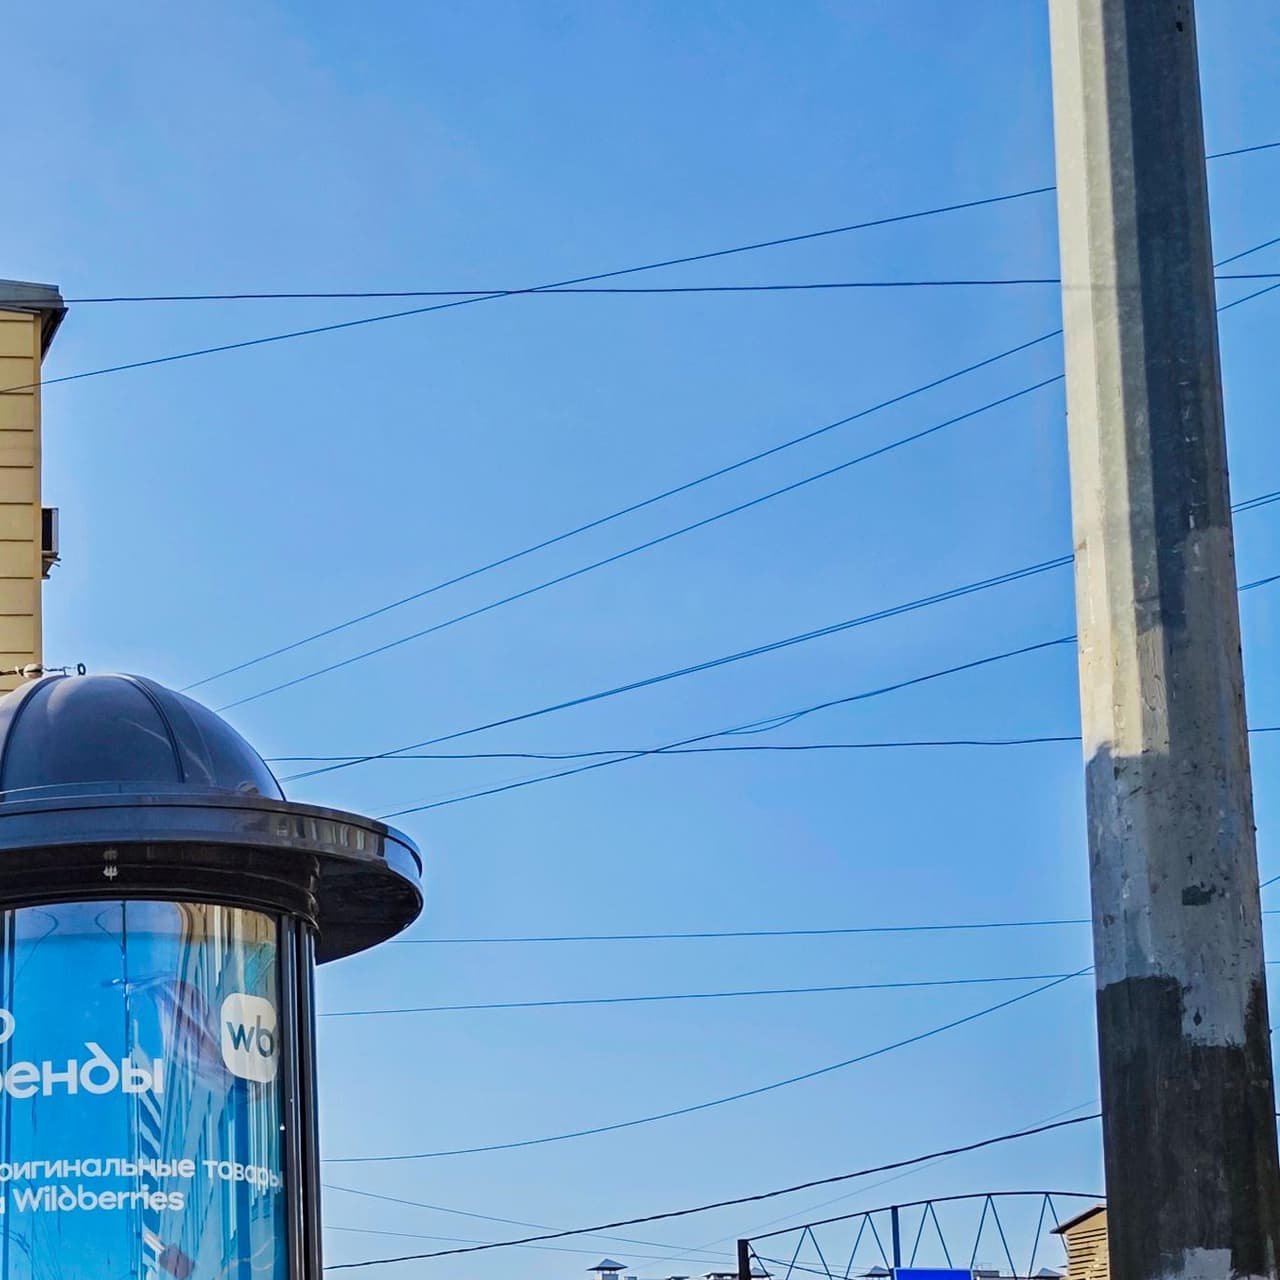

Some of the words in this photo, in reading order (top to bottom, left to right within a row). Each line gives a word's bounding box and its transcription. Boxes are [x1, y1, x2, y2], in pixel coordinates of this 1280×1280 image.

[226, 1015, 275, 1058] wb
[202, 1159, 284, 1192] товары
[12, 1184, 185, 1213] Wildberries
